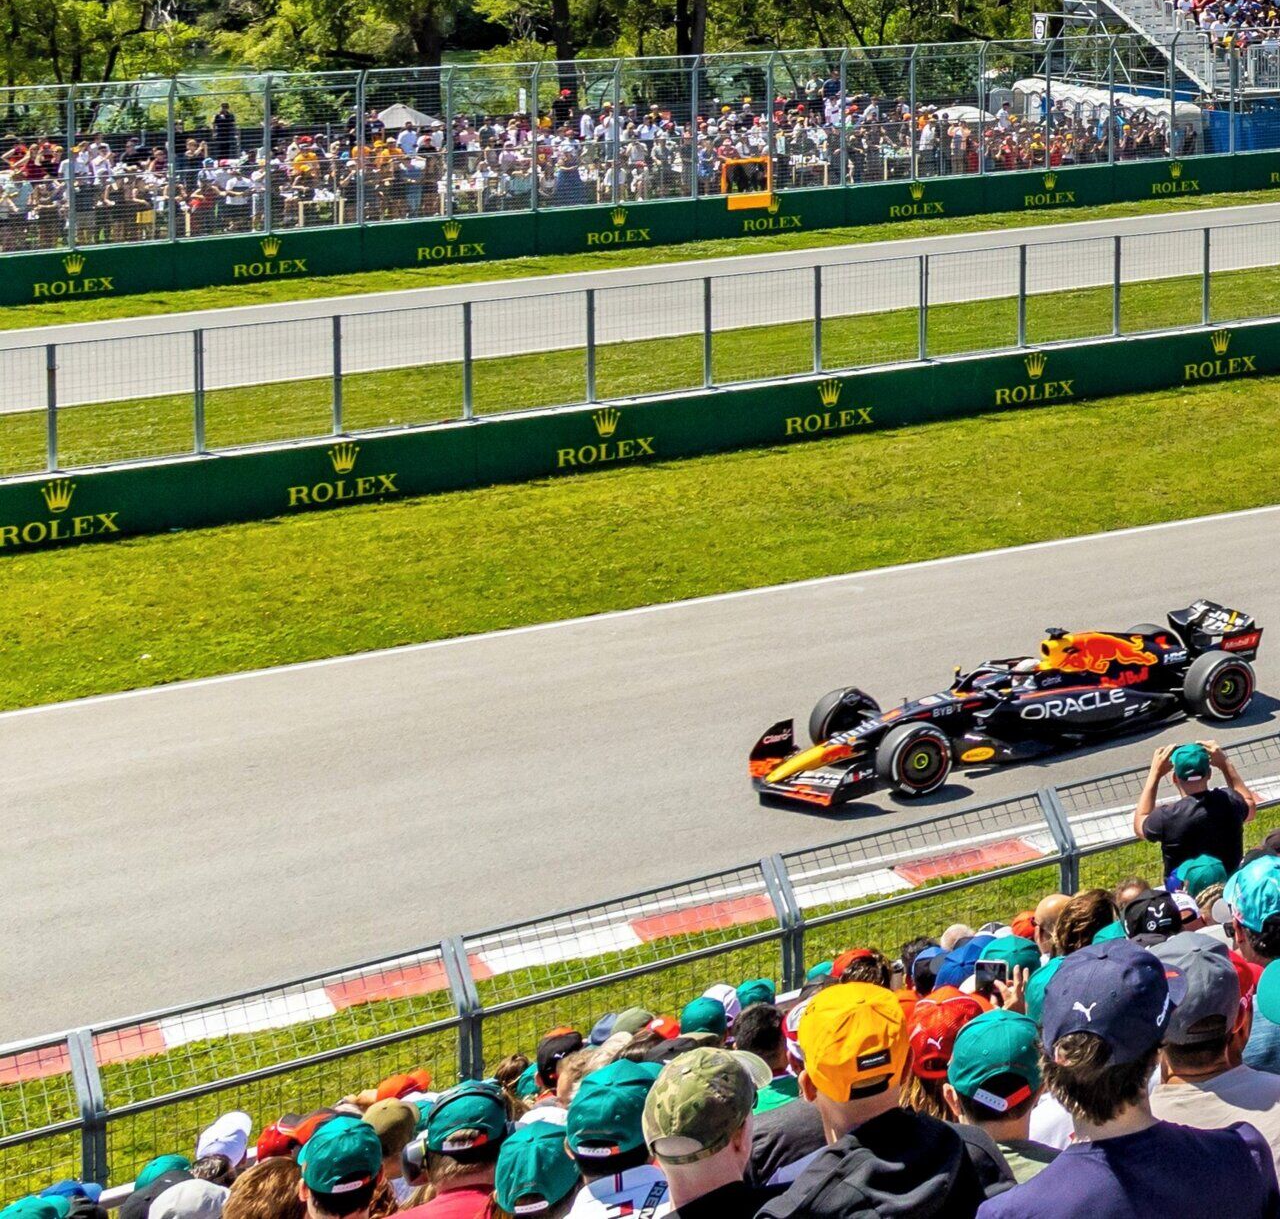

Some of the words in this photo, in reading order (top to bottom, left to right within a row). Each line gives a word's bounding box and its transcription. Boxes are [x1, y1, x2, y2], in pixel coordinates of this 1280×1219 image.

[1152, 180, 1199, 193] ROLEX
[1025, 192, 1074, 206] ROLEX
[890, 202, 944, 217] ROLEX
[744, 216, 801, 231] ROLEX
[587, 229, 650, 244] ROLEX
[418, 244, 484, 260] ROLEX
[234, 260, 306, 277] ROLEX
[34, 277, 113, 296] ROLEX
[1185, 356, 1255, 379] ROLEX
[996, 381, 1072, 405] ROLEX
[786, 408, 872, 435] ROLEX
[558, 437, 654, 467] ROLEX
[288, 474, 396, 505] ROLEX
[0, 513, 118, 546] ROLEX
[1100, 669, 1128, 687] Red
[1127, 666, 1149, 683] Bull
[1020, 688, 1127, 720] ORACLE
[762, 732, 791, 744] Claro
